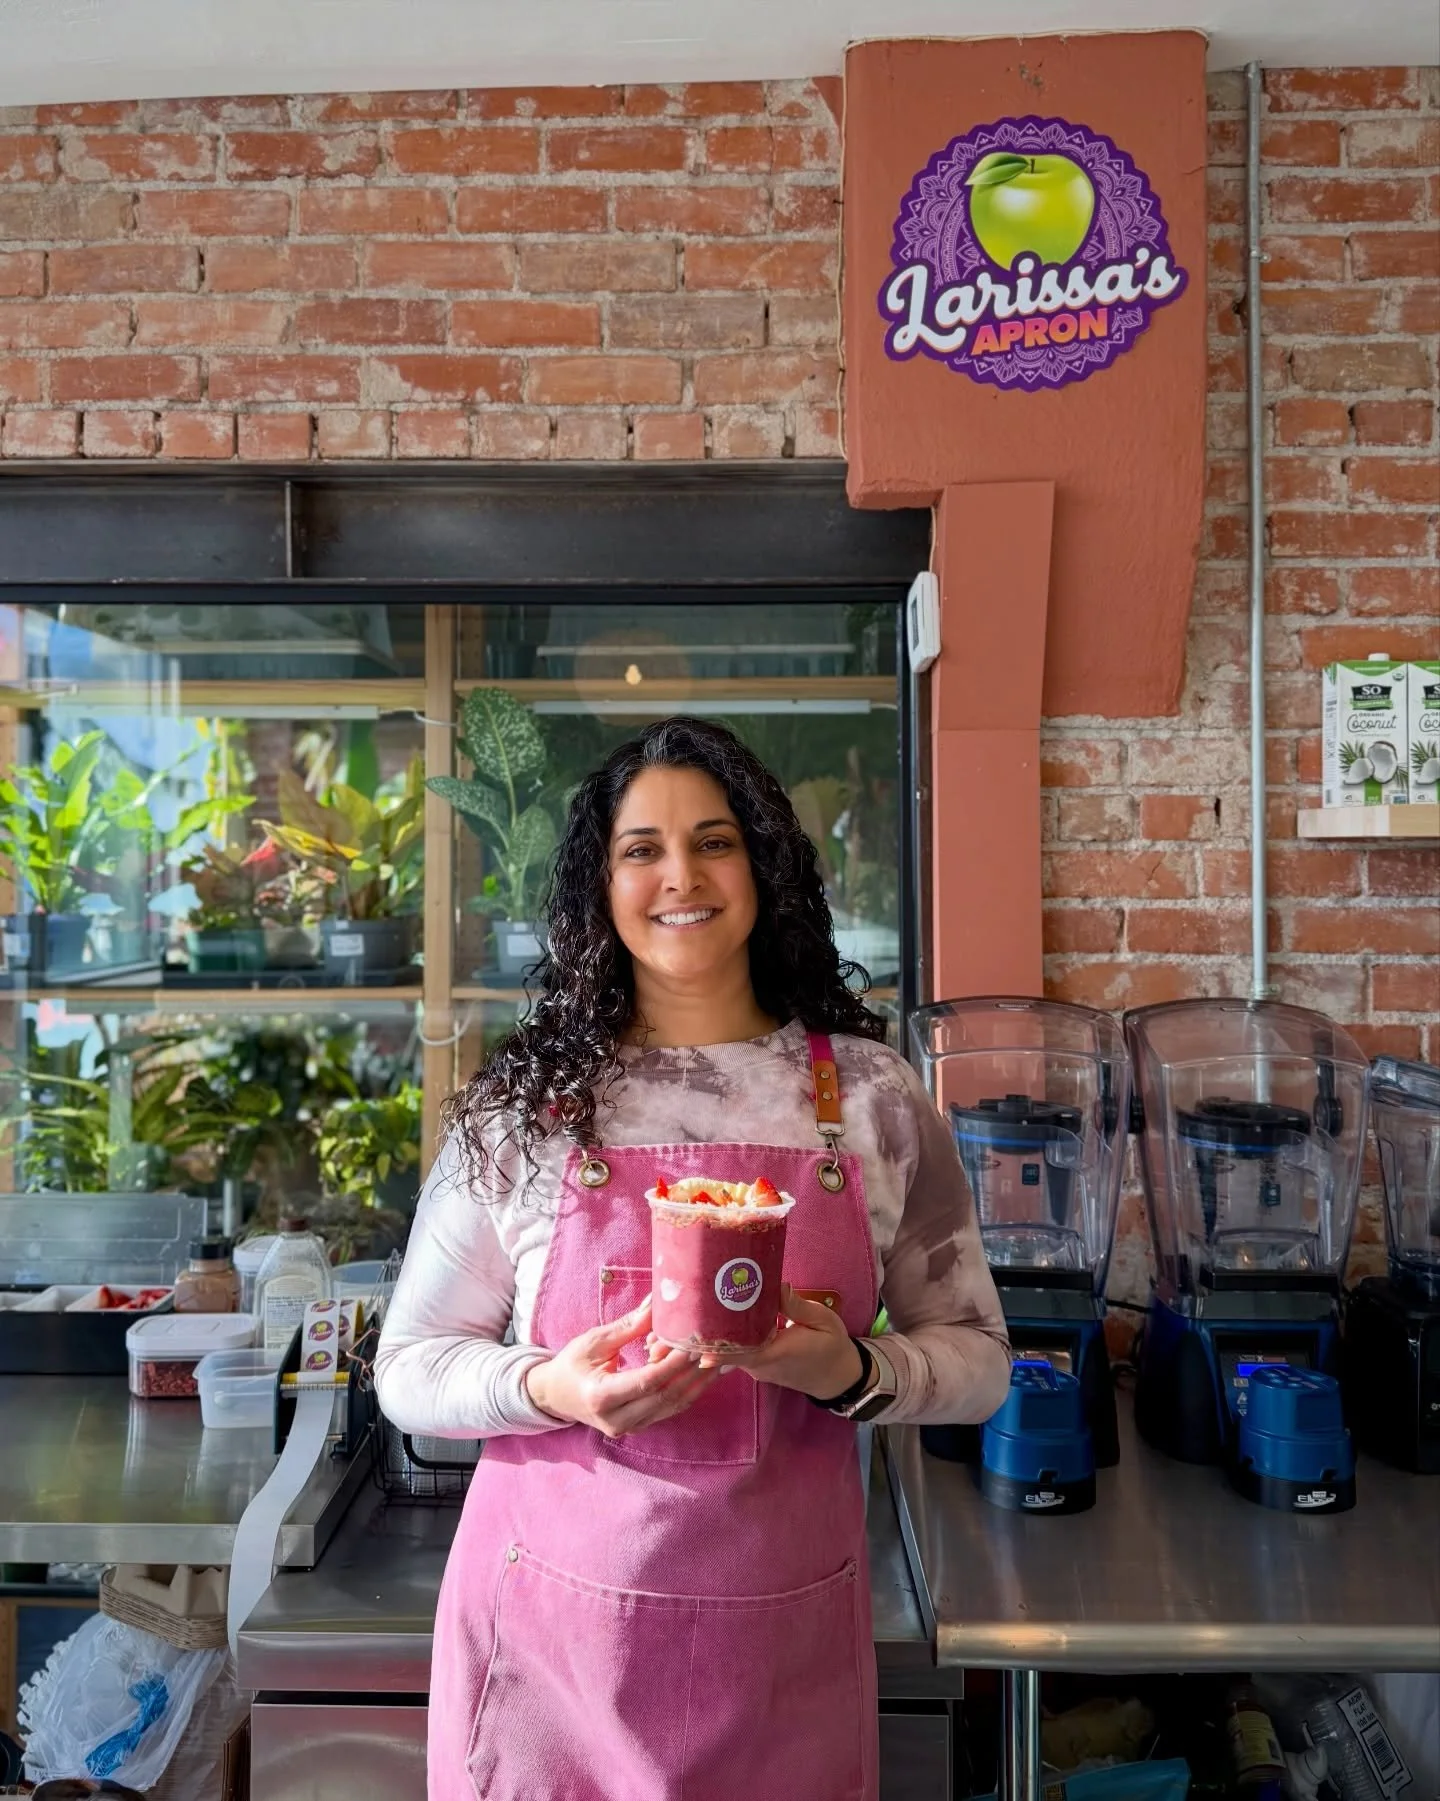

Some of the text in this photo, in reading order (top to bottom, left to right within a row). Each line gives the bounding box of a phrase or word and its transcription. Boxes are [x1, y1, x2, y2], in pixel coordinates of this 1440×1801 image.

[886, 247, 1180, 352] Larissa's
[972, 308, 1108, 355] APRON
[1361, 686, 1382, 695] SO
[1347, 713, 1399, 733] Coconut
[721, 1279, 759, 1299] Larissa's
